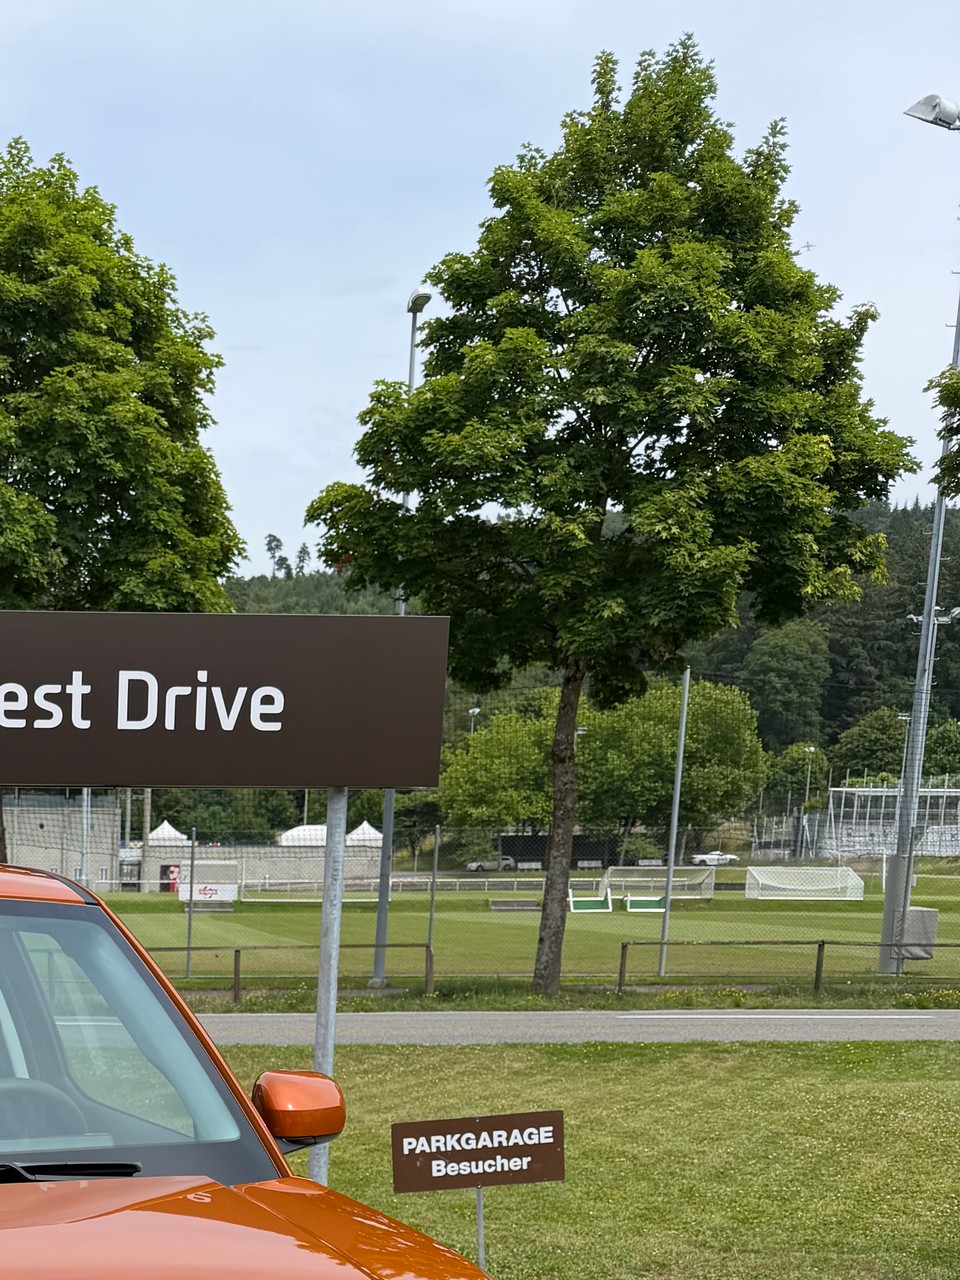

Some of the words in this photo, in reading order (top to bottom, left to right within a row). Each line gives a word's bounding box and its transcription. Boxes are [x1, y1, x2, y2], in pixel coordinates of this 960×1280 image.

[116, 670, 286, 732] Drive
[402, 1126, 554, 1155] PARKGARAGE
[431, 1155, 532, 1177] Besucher
